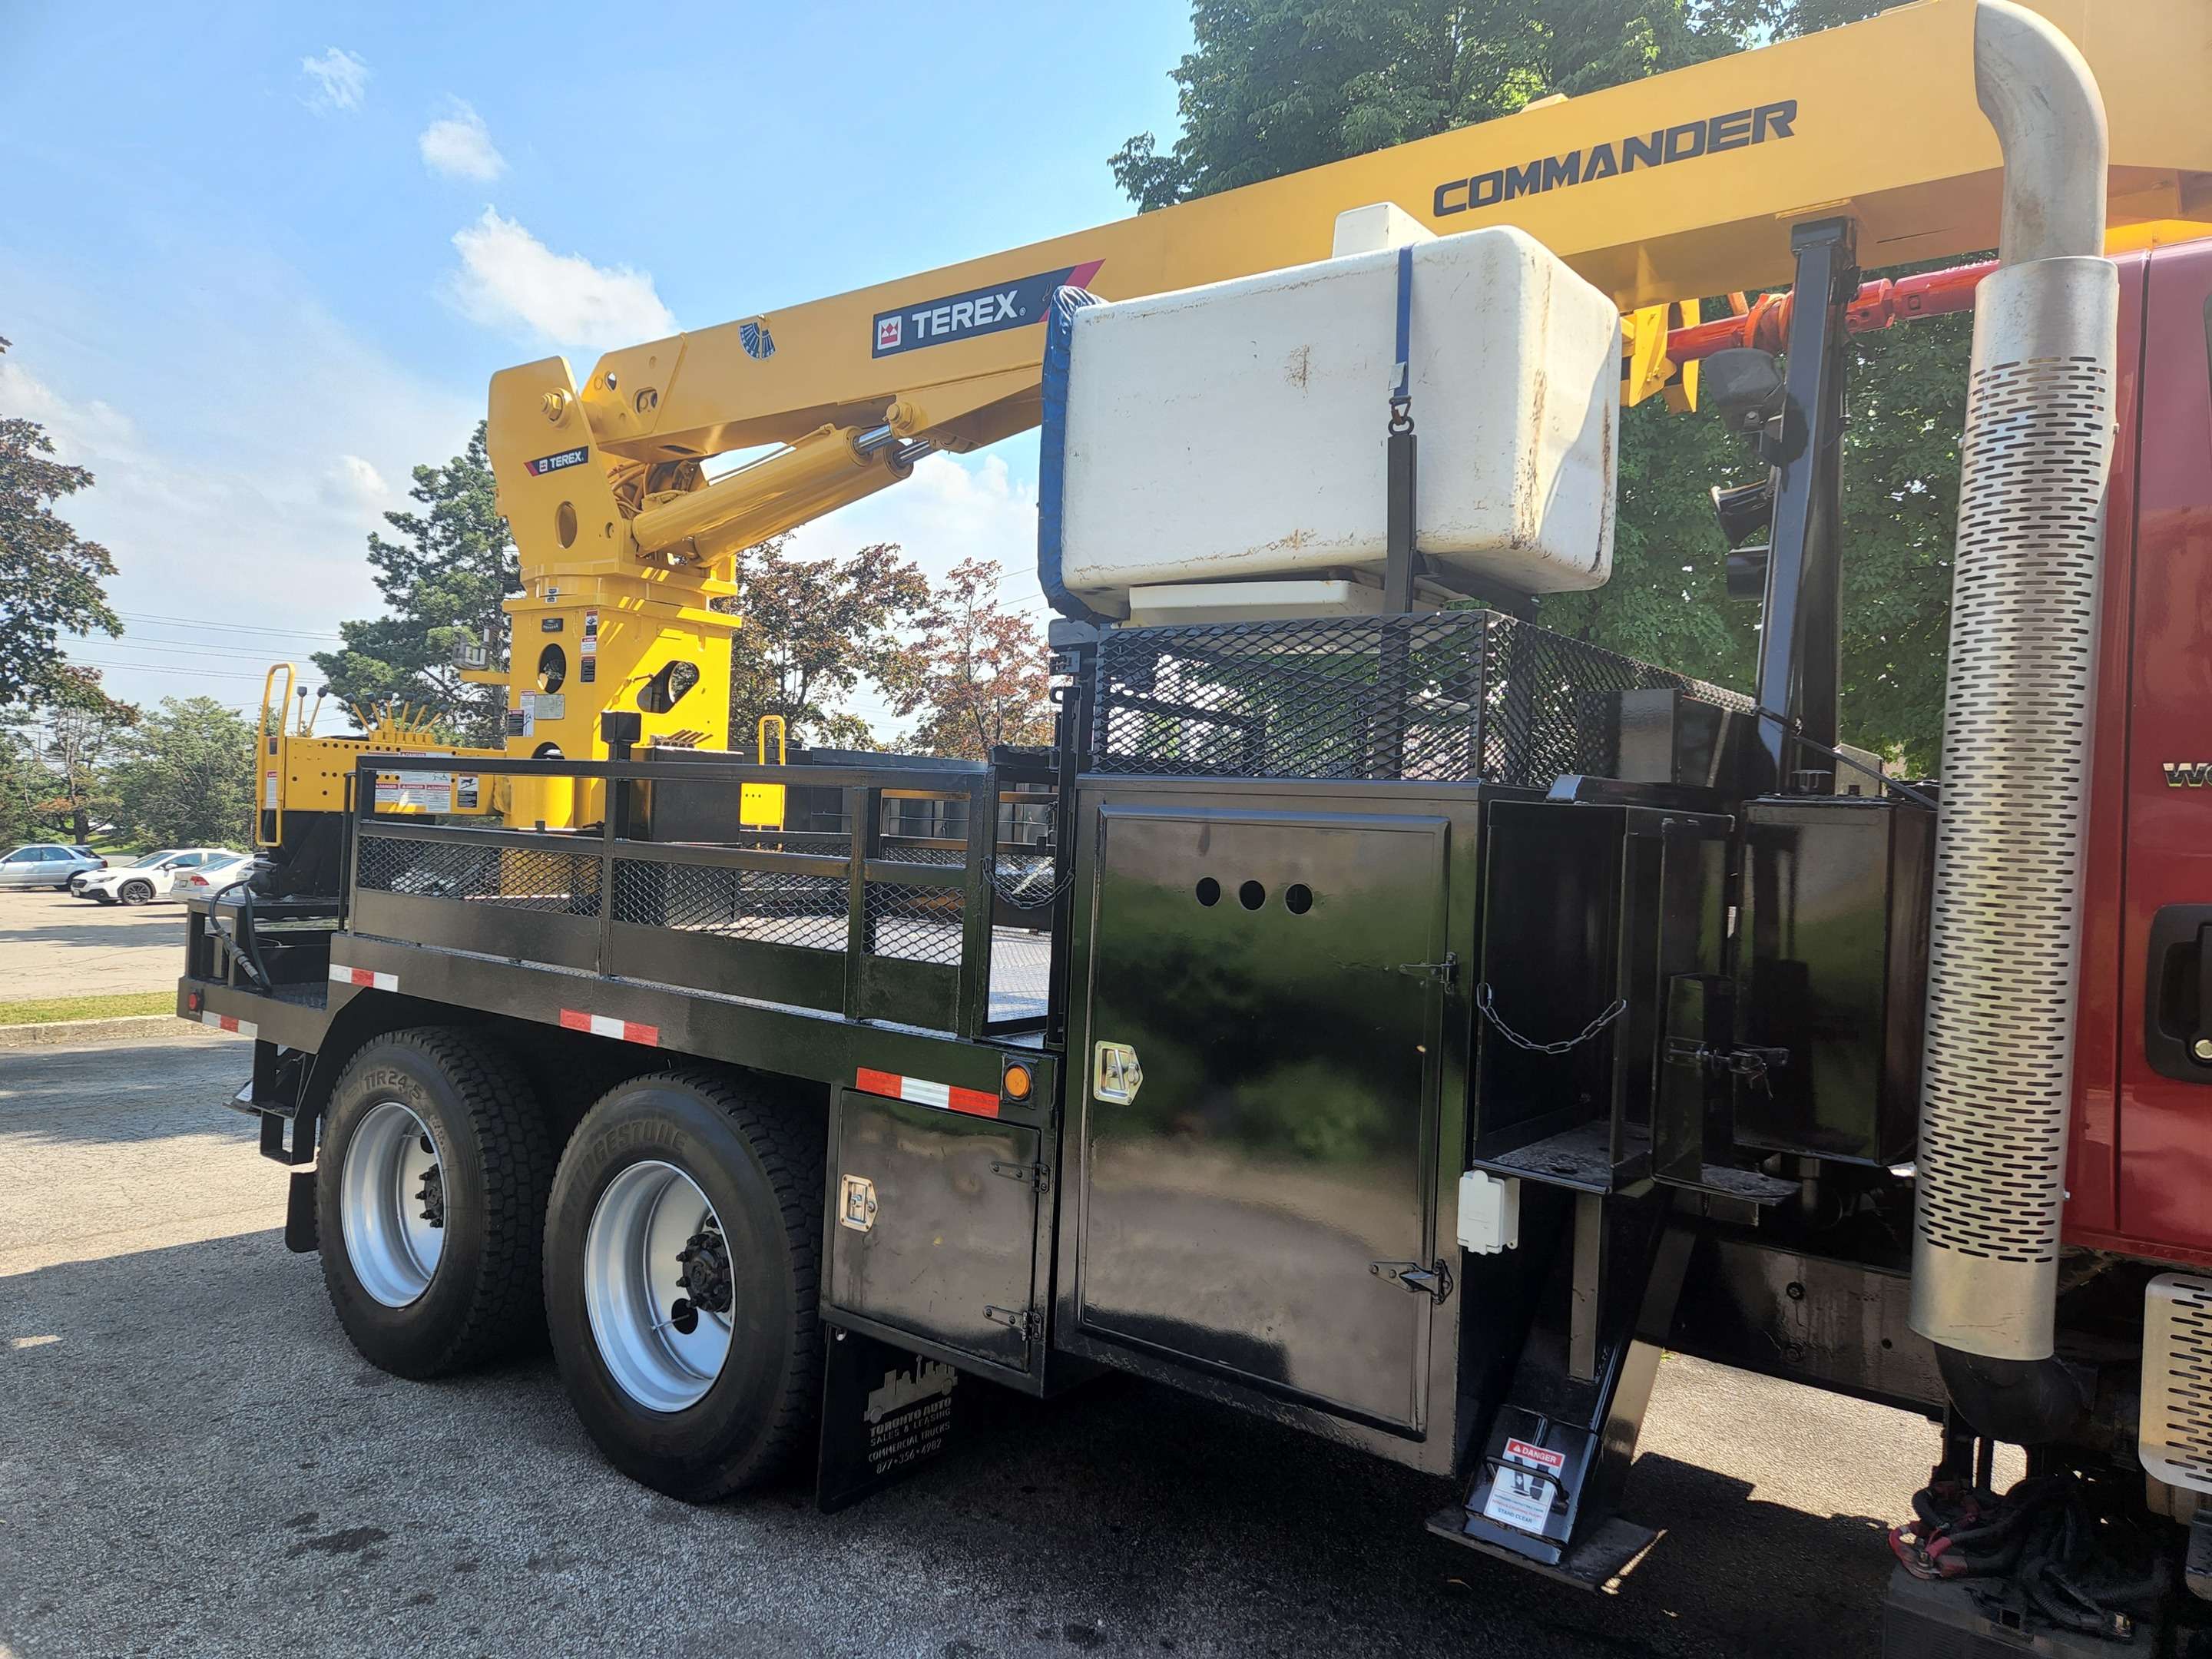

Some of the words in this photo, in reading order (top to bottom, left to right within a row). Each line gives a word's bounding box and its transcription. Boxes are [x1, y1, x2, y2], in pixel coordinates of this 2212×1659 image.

[1433, 99, 1798, 218] COMMANDER
[912, 290, 1018, 339] TEREX
[549, 451, 581, 469] TEREX
[869, 1409, 922, 1438] TORONTO
[923, 1397, 952, 1417] AUTO
[870, 1429, 899, 1447] SALES
[868, 1434, 918, 1462] COMMERCIAL
[921, 1421, 951, 1440] TRUCKS
[1522, 1445, 1557, 1464] DANGER
